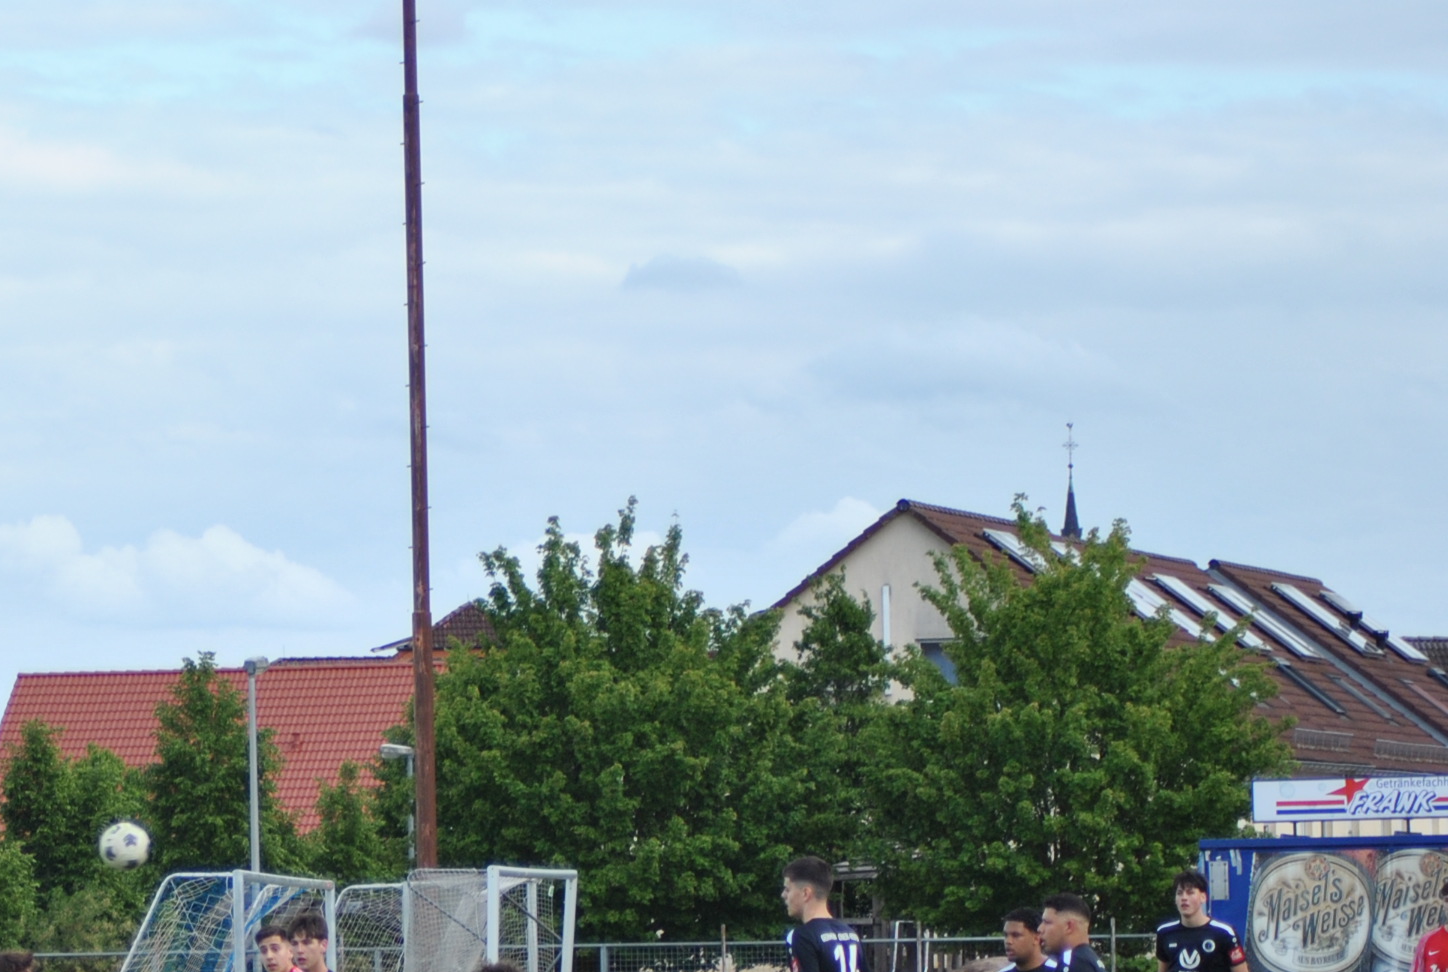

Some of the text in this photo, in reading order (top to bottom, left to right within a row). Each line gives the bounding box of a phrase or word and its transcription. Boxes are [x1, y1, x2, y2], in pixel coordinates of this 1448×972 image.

[1350, 790, 1437, 815] FRANK
[1258, 869, 1344, 943] Maisel's
[1293, 895, 1364, 948] Weisse
